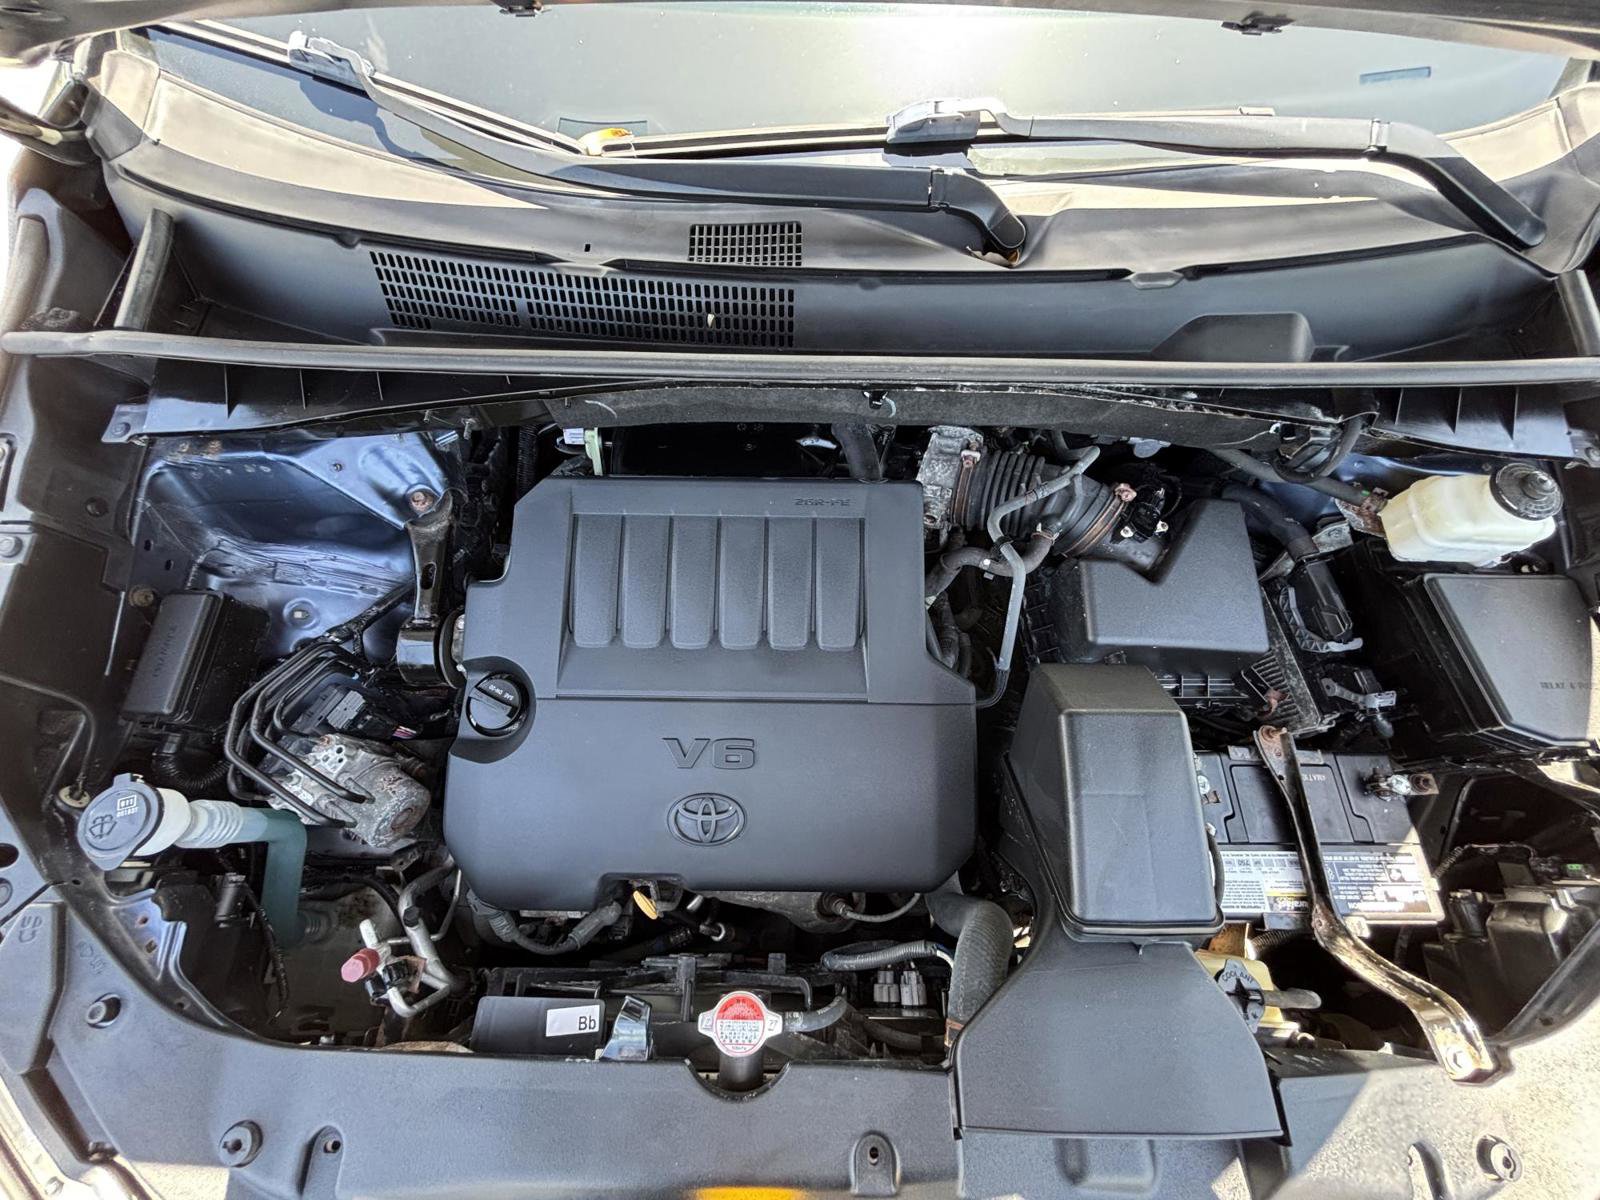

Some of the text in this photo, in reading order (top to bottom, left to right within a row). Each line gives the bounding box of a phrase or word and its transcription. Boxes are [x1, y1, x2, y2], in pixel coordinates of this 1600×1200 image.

[794, 498, 851, 506] 2GR-FE
[661, 737, 756, 770] V6
[1221, 970, 1254, 984] COOLANT
[578, 1015, 597, 1031] Bb
